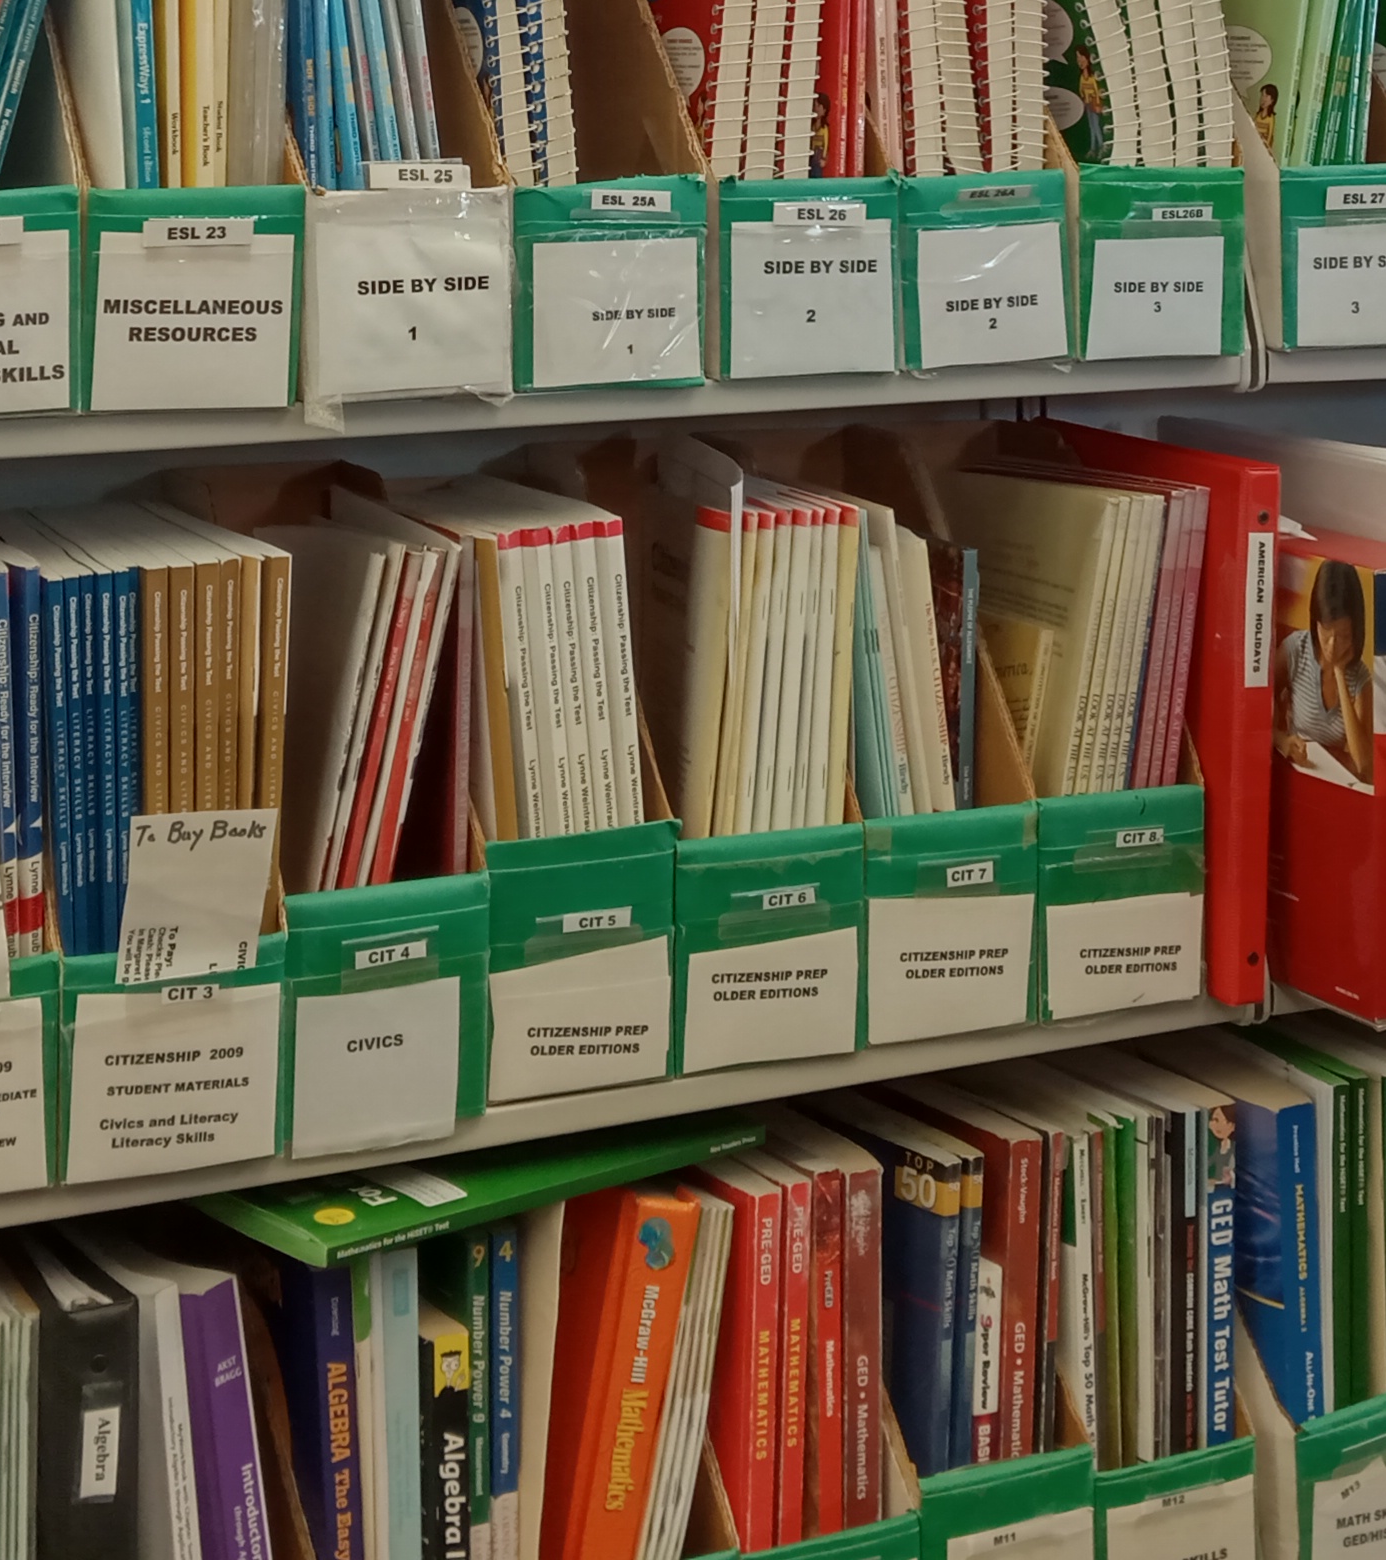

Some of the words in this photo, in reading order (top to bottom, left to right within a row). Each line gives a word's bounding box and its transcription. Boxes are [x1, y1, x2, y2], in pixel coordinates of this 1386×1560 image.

[104, 299, 283, 314] MISCELLANEOUS
[358, 280, 404, 295] SIDE
[411, 278, 437, 292] BY
[444, 276, 489, 291] SIDE
[129, 327, 256, 342] RESOURCES
[1257, 542, 1265, 603] AMERICAN
[1253, 614, 1263, 672] HOLIDAYS
[899, 948, 975, 964] CITIZENSHIP
[979, 948, 1008, 959] PREP
[906, 968, 945, 979] OLDER
[949, 965, 1003, 977] EDITIONS
[347, 1034, 403, 1052] CIVICS
[107, 1083, 171, 1096] STUDENT
[175, 1077, 249, 1092] MATERIALS
[1211, 1199, 1232, 1245] GED
[1214, 1255, 1231, 1309] Math
[631, 1285, 660, 1382] McGraw-Hill
[1215, 1326, 1229, 1363] Test
[327, 1363, 350, 1463] ALGEBRA
[1214, 1377, 1229, 1431] Tutor
[94, 1418, 111, 1481] Algebra
[606, 1388, 649, 1510] Mathematics
